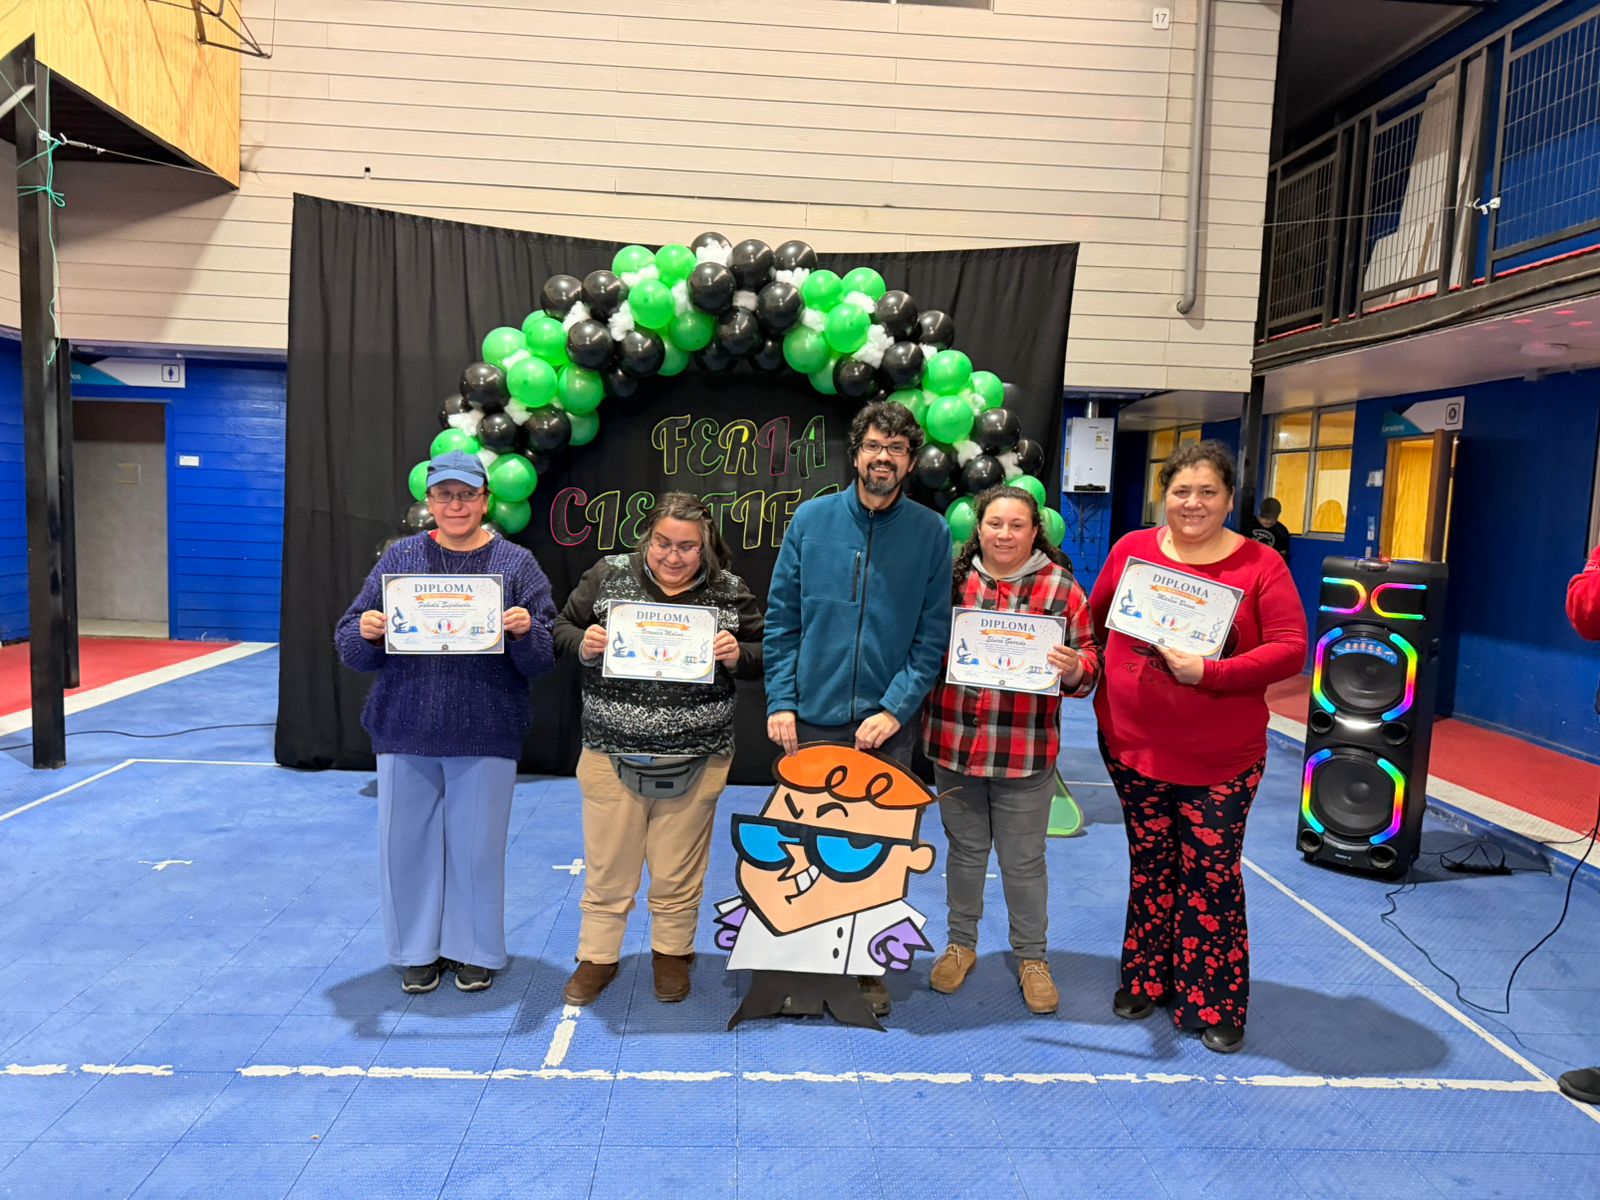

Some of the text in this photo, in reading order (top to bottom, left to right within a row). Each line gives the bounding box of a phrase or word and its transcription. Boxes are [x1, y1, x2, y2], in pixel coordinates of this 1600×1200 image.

[1155, 13, 1167, 24] 17
[651, 414, 826, 479] FERIA
[414, 583, 474, 593] DIPLOMA
[1152, 573, 1209, 599] DIPLOMA
[636, 610, 690, 623] DIPLOMA
[980, 618, 1036, 632] DIPLOMA
